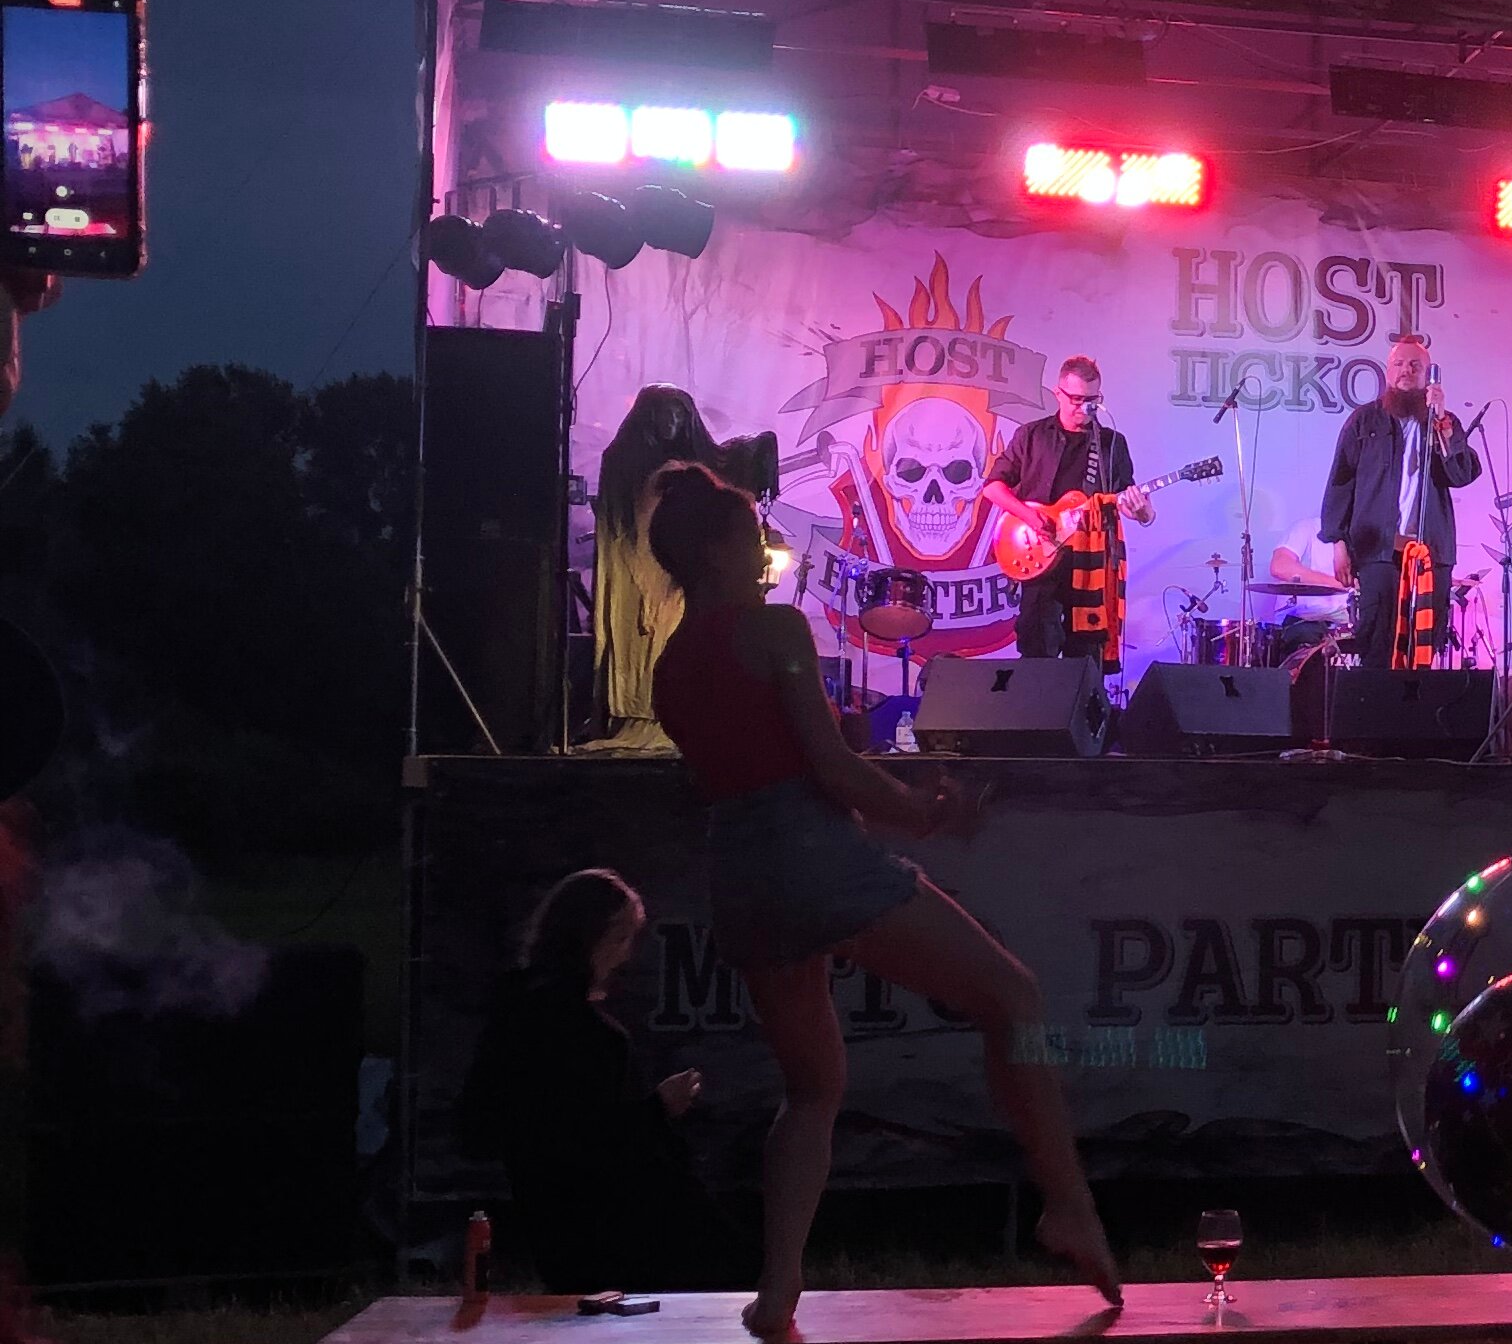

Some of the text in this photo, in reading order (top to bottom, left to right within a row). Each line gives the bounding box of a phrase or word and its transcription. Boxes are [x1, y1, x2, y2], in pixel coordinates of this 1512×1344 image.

[1169, 246, 1446, 349] HOST
[859, 335, 1016, 384] HOST
[1168, 349, 1392, 415] ПСКО
